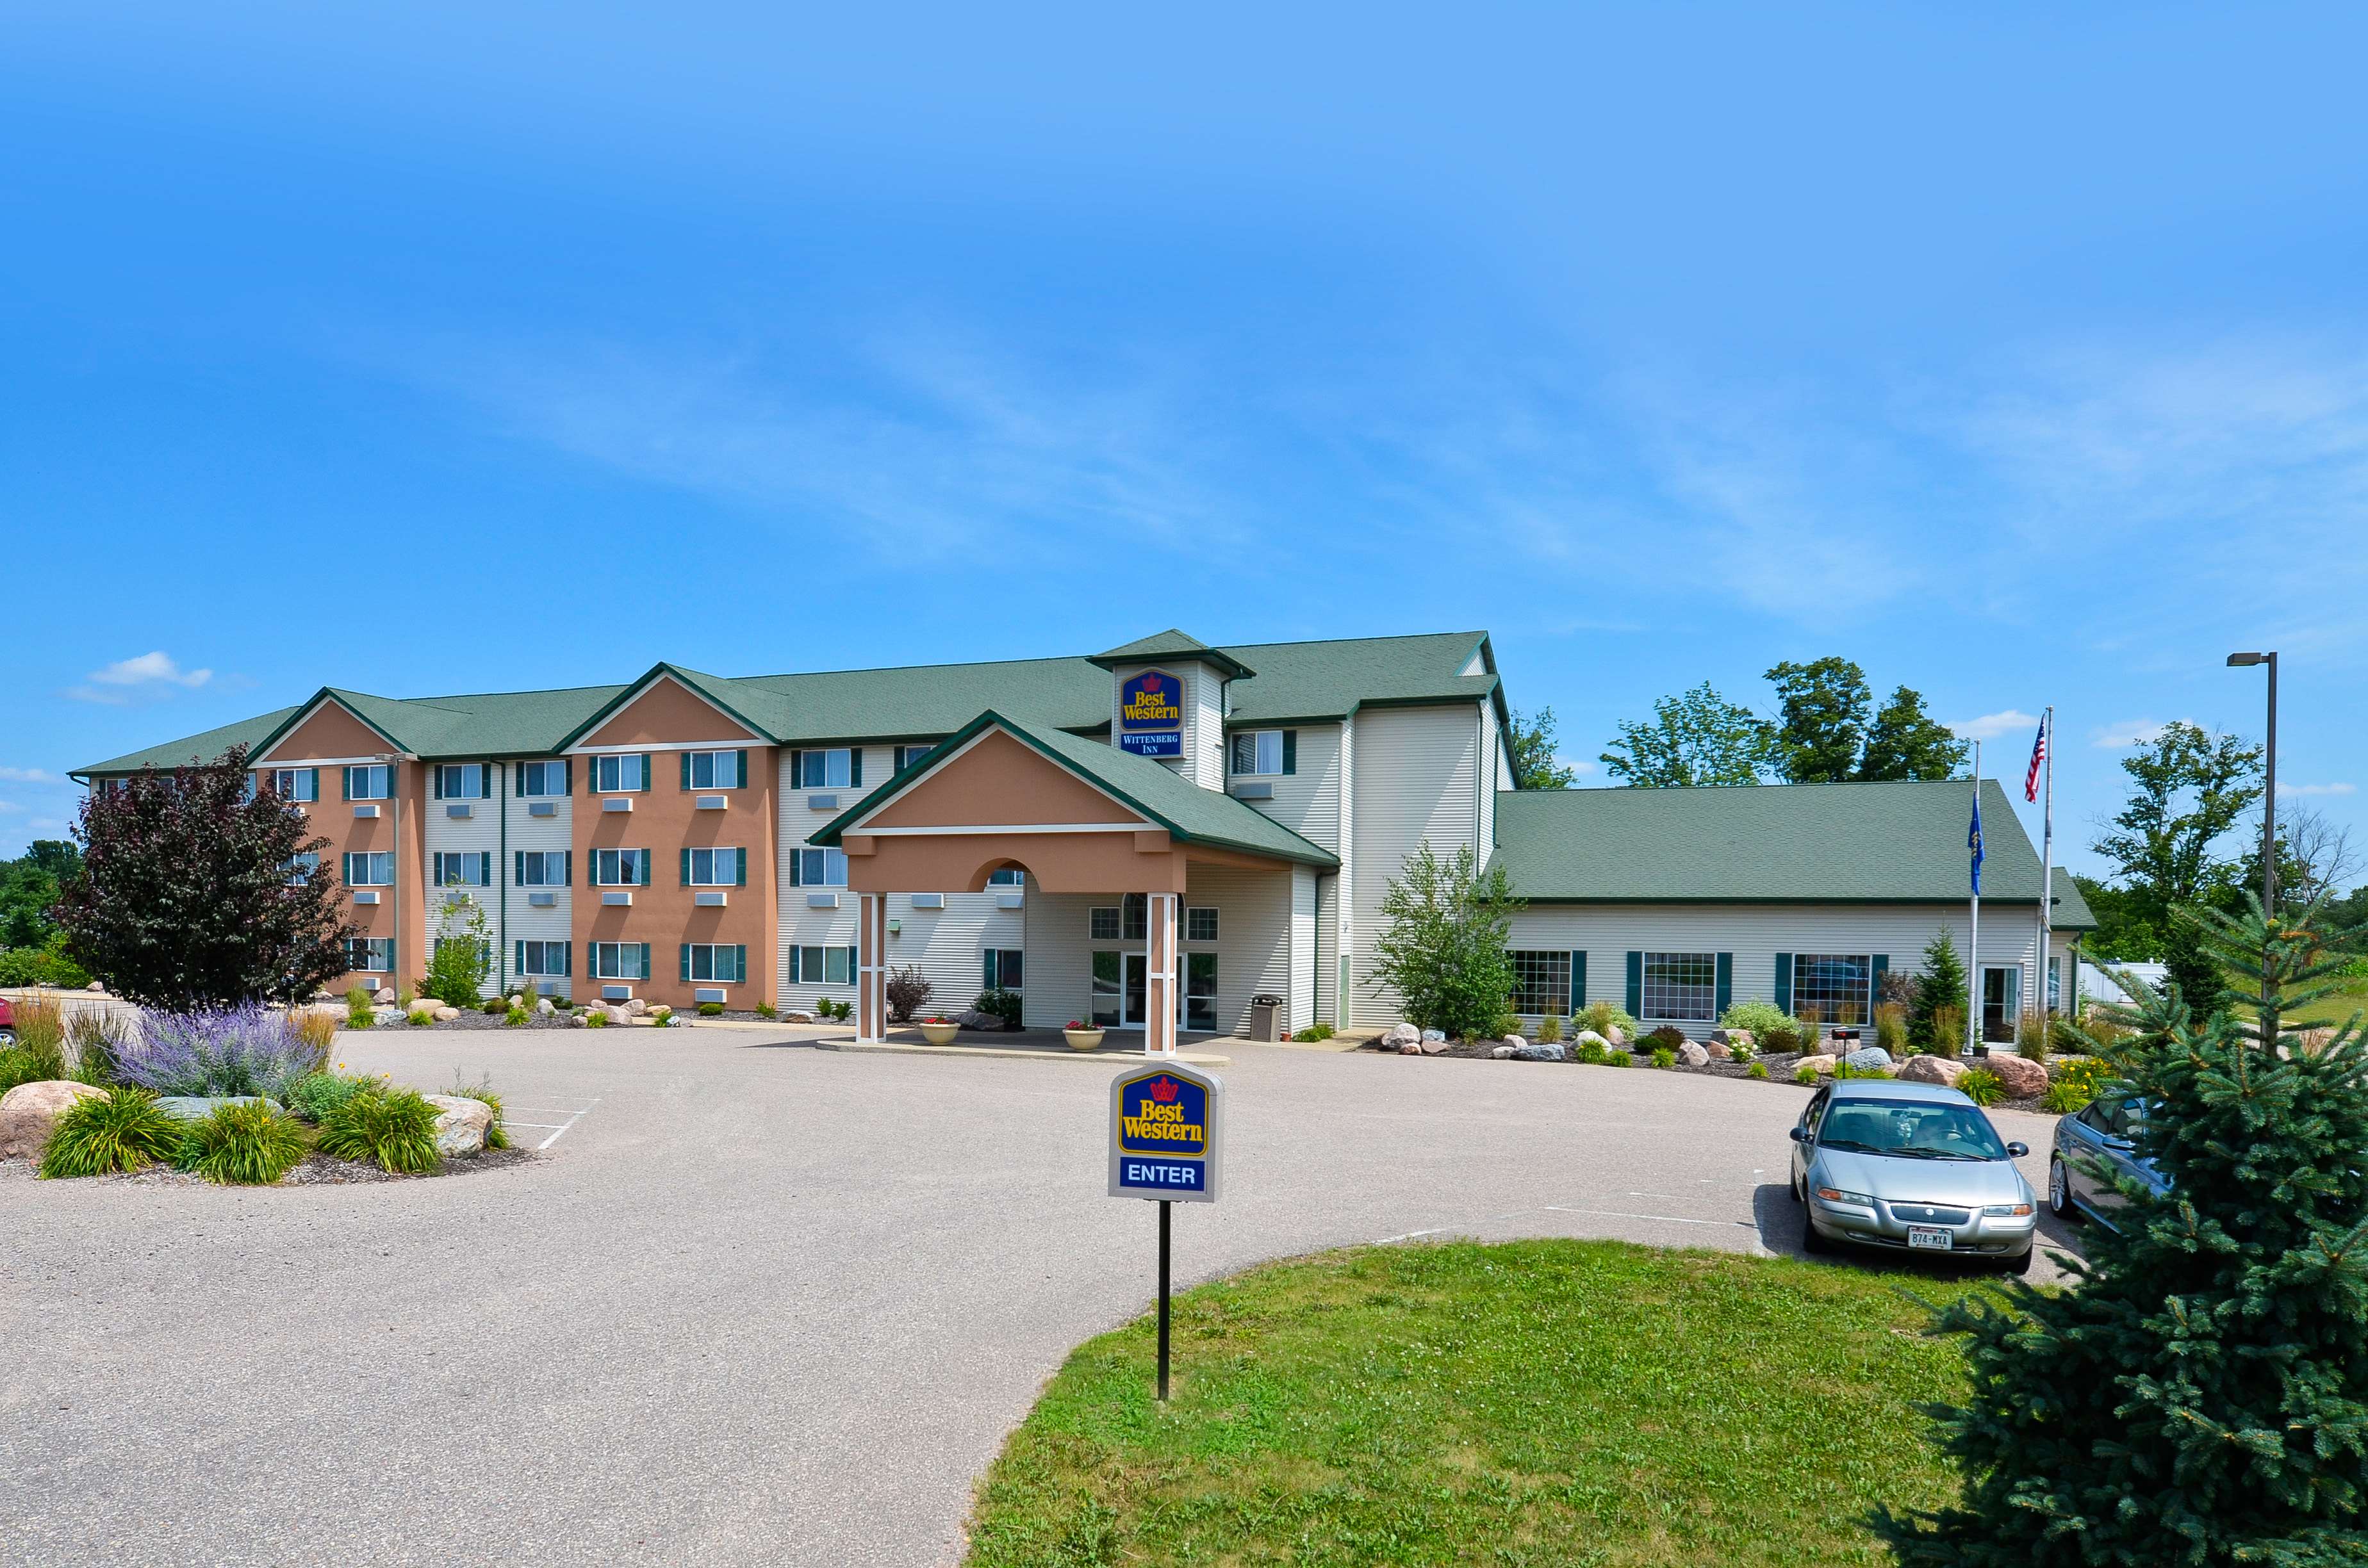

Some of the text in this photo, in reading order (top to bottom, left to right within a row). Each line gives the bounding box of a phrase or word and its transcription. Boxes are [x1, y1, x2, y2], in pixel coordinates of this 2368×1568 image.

[1135, 691, 1165, 706] Best
[1124, 705, 1178, 720] Western
[1124, 735, 1178, 744] WITTENBERG
[1142, 745, 1158, 754] INN
[1140, 1100, 1184, 1122] Best
[1123, 1116, 1203, 1141] Western
[1128, 1164, 1196, 1184] ENTER
